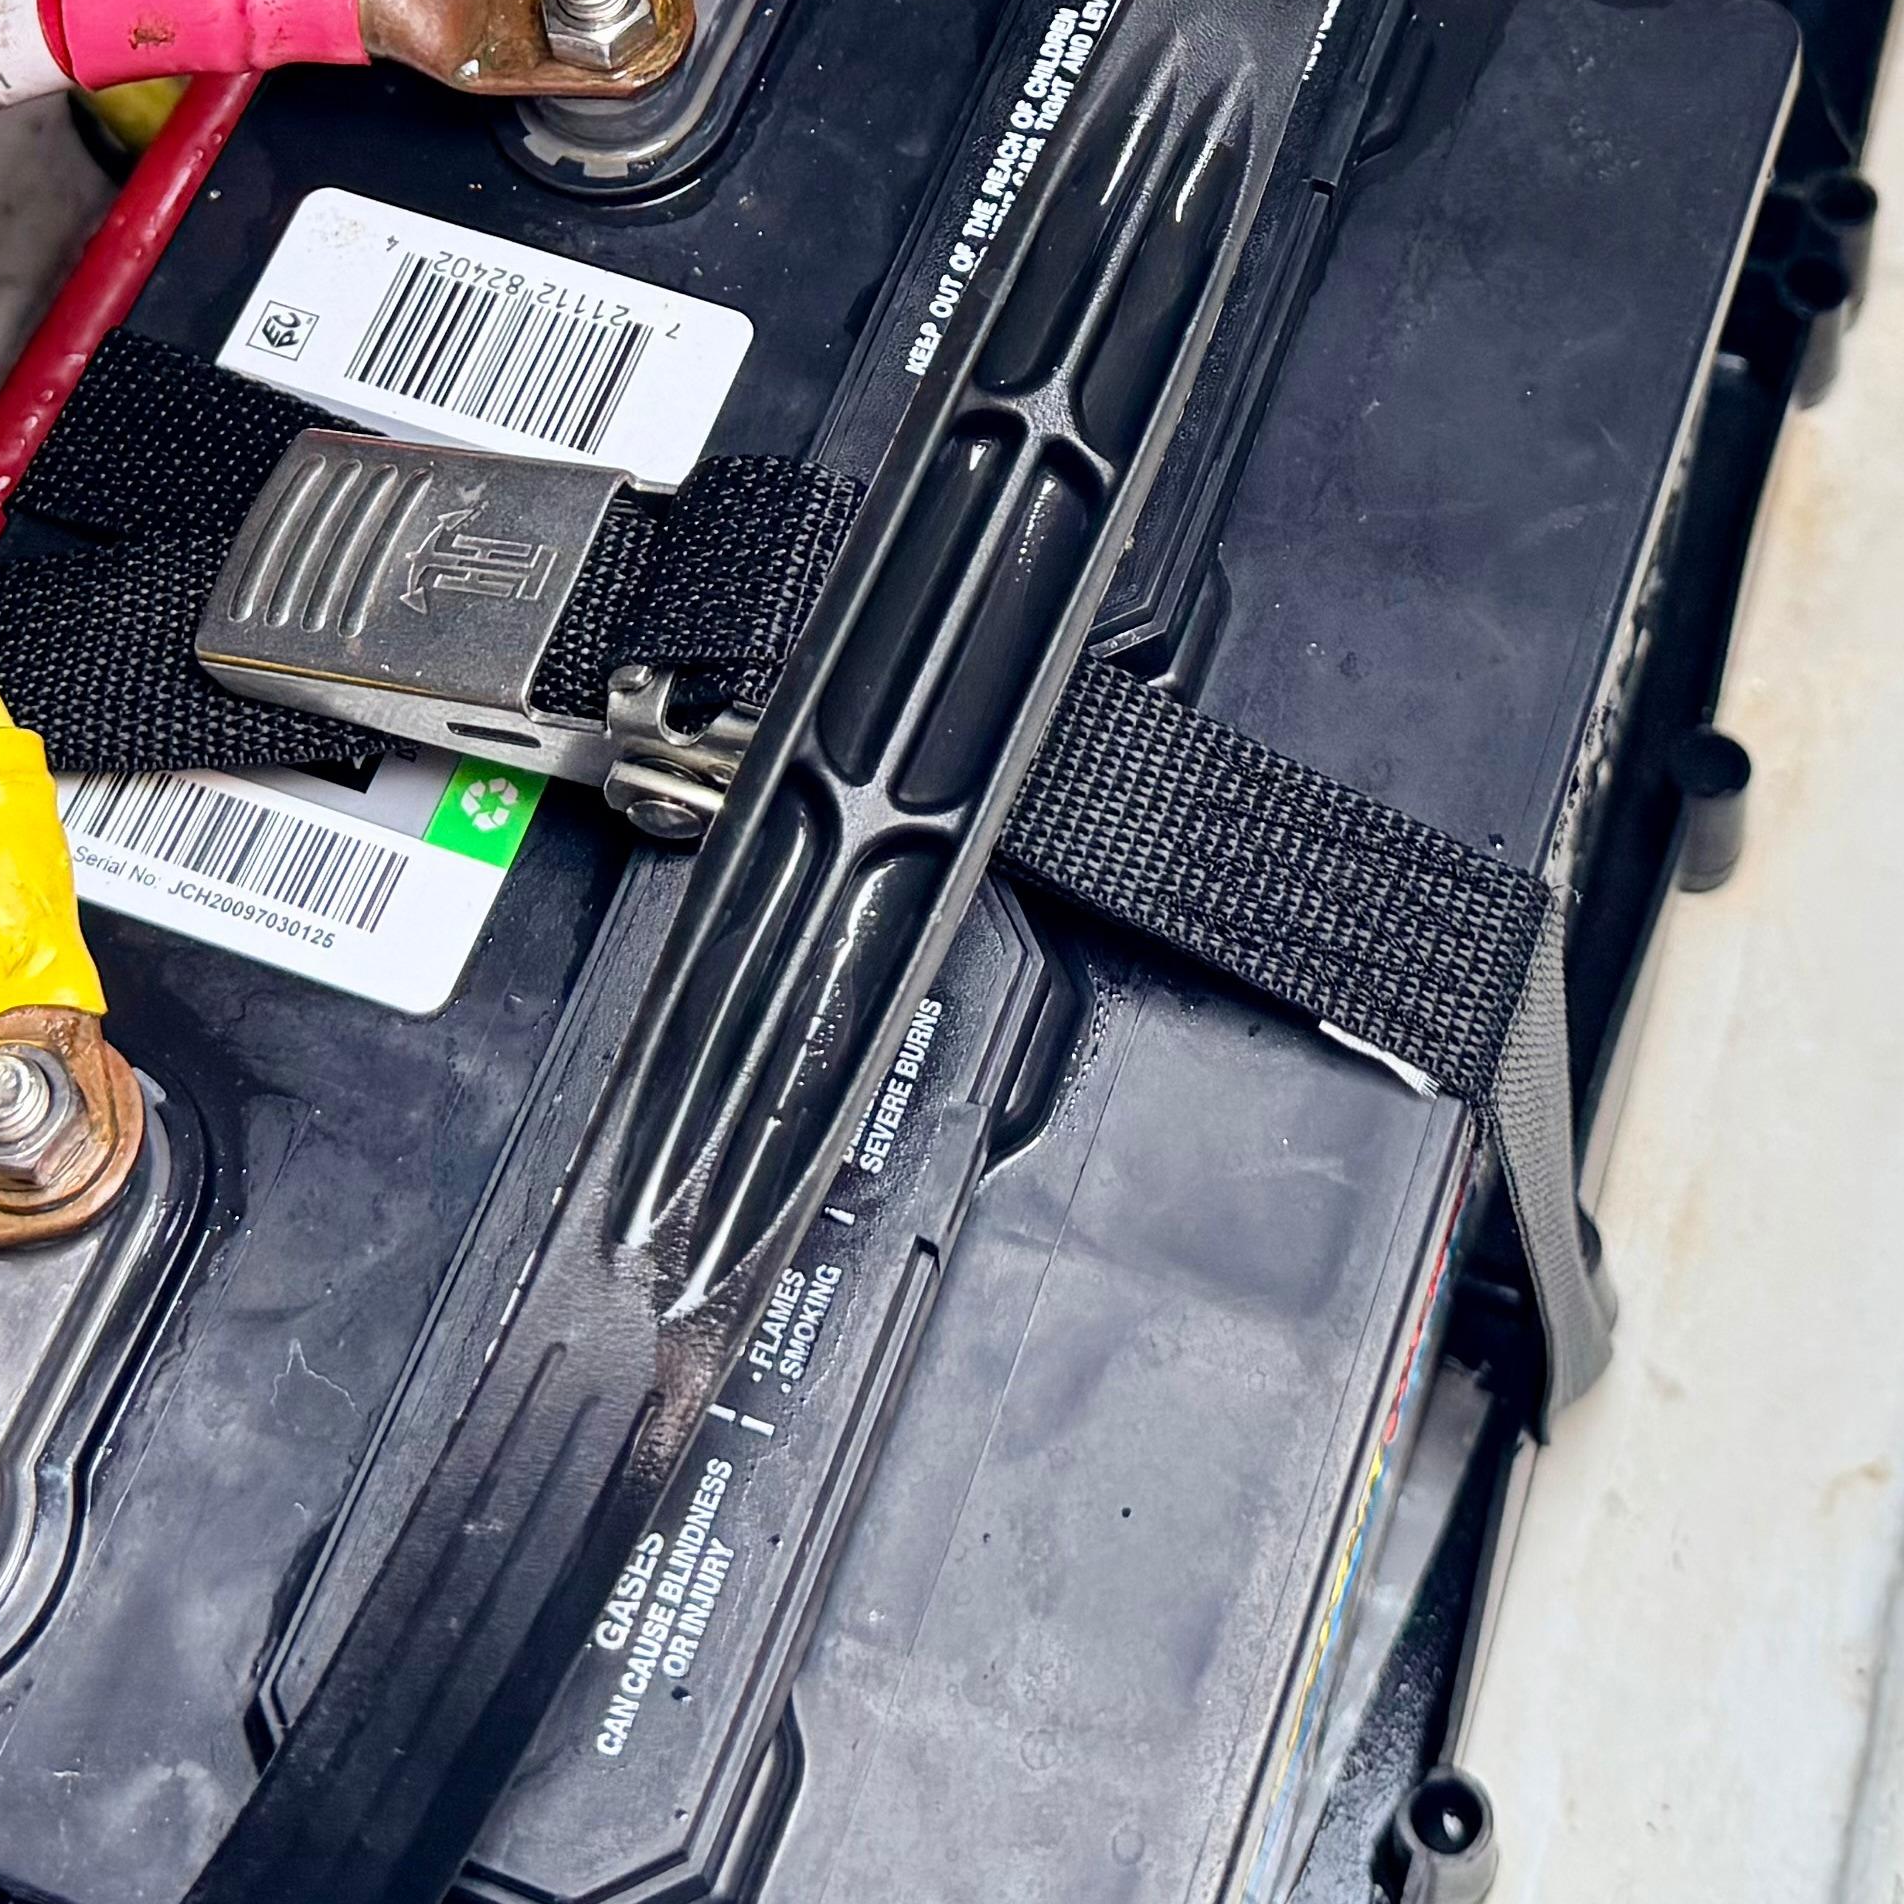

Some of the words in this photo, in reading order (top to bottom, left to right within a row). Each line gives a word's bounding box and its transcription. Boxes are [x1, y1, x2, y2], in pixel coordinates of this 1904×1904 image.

[1024, 4, 1079, 99] CHILDREN
[1034, 73, 1074, 132] TIGHT
[1062, 29, 1093, 74] AND
[1010, 98, 1036, 131] OF
[981, 129, 1026, 197] REACH
[383, 234, 399, 252] 4
[962, 196, 997, 239] THE
[431, 249, 525, 296] 82402
[948, 239, 977, 275] OF
[535, 281, 629, 328] 21112
[927, 273, 963, 320] OUT
[664, 320, 682, 340] 7
[905, 319, 944, 375] KEEP
[72, 844, 126, 876] Serial
[128, 863, 163, 889] No:
[167, 877, 337, 950] JCH20097030125
[856, 1077, 912, 1175] SEVERE
[894, 996, 943, 1079] BURNS
[748, 1265, 808, 1369] FLAMES
[778, 1262, 843, 1380] SMOKING
[591, 1526, 667, 1653] GASES
[592, 1692, 640, 1758] CAN
[617, 1600, 677, 1698] CAUSE
[655, 1455, 735, 1604] BLINDNESS
[677, 1536, 738, 1637] INJURY
[659, 1632, 699, 1681] OR
